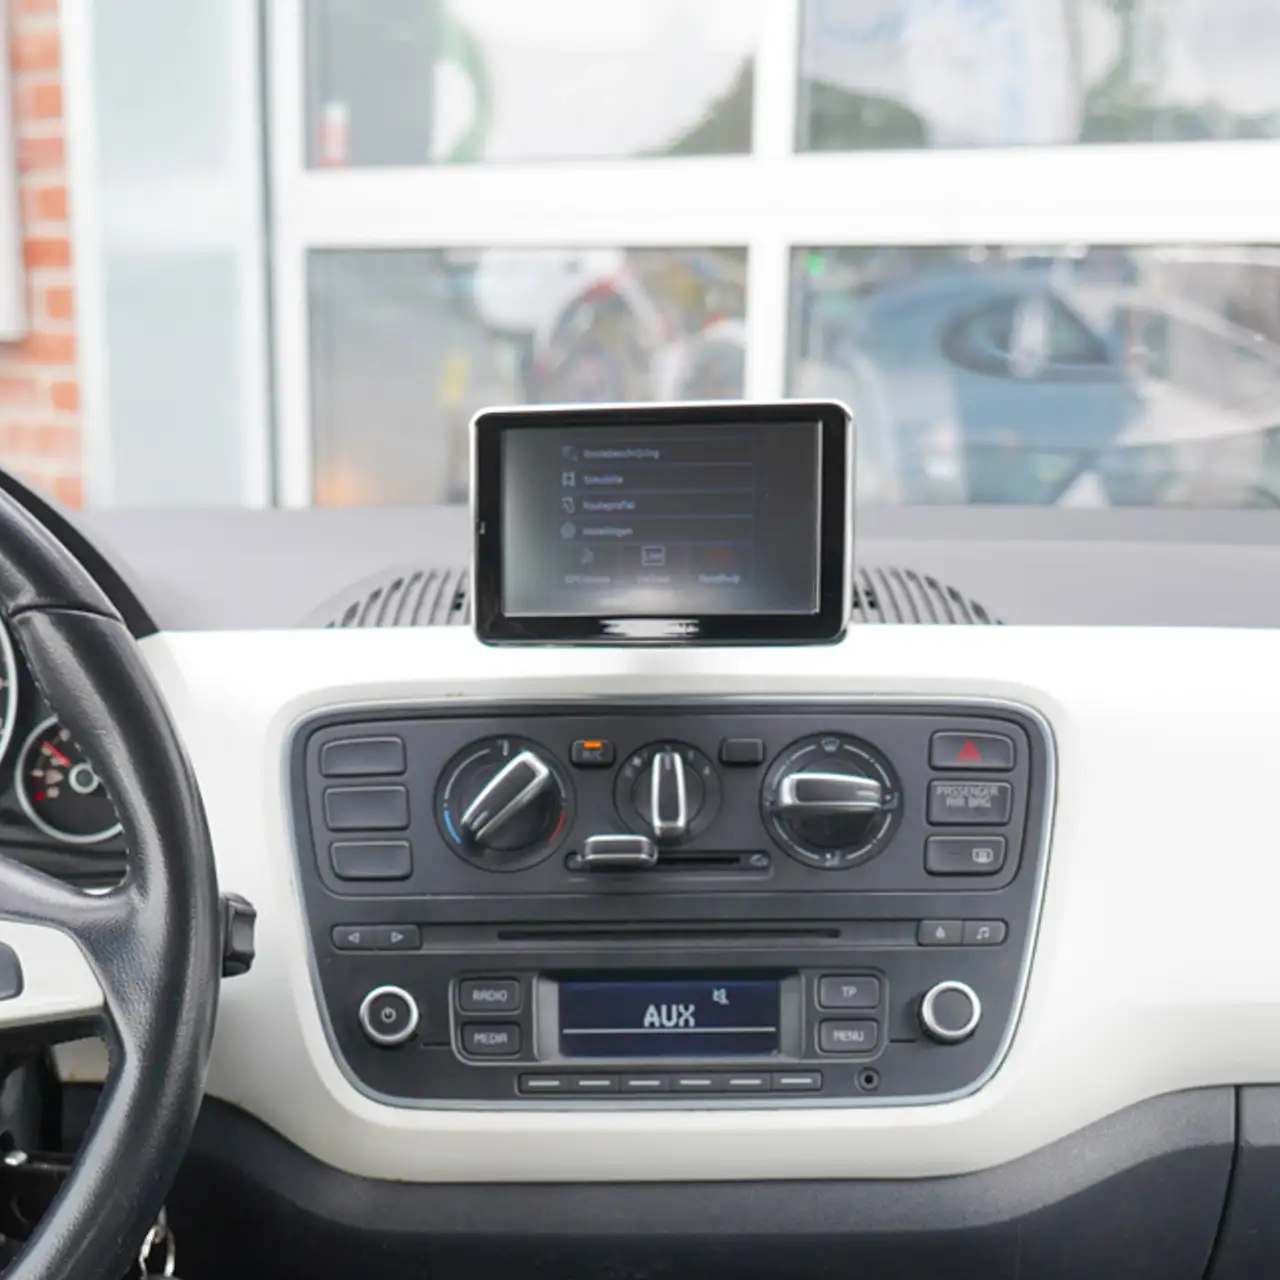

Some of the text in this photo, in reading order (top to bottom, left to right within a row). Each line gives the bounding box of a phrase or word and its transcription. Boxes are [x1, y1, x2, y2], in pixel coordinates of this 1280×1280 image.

[935, 786, 999, 797] PASSENGER
[472, 989, 508, 1002] RADIO
[841, 986, 857, 998] TP
[643, 1004, 696, 1028] AUX
[473, 1032, 508, 1044] MEDIA
[833, 1030, 864, 1042] MENU
